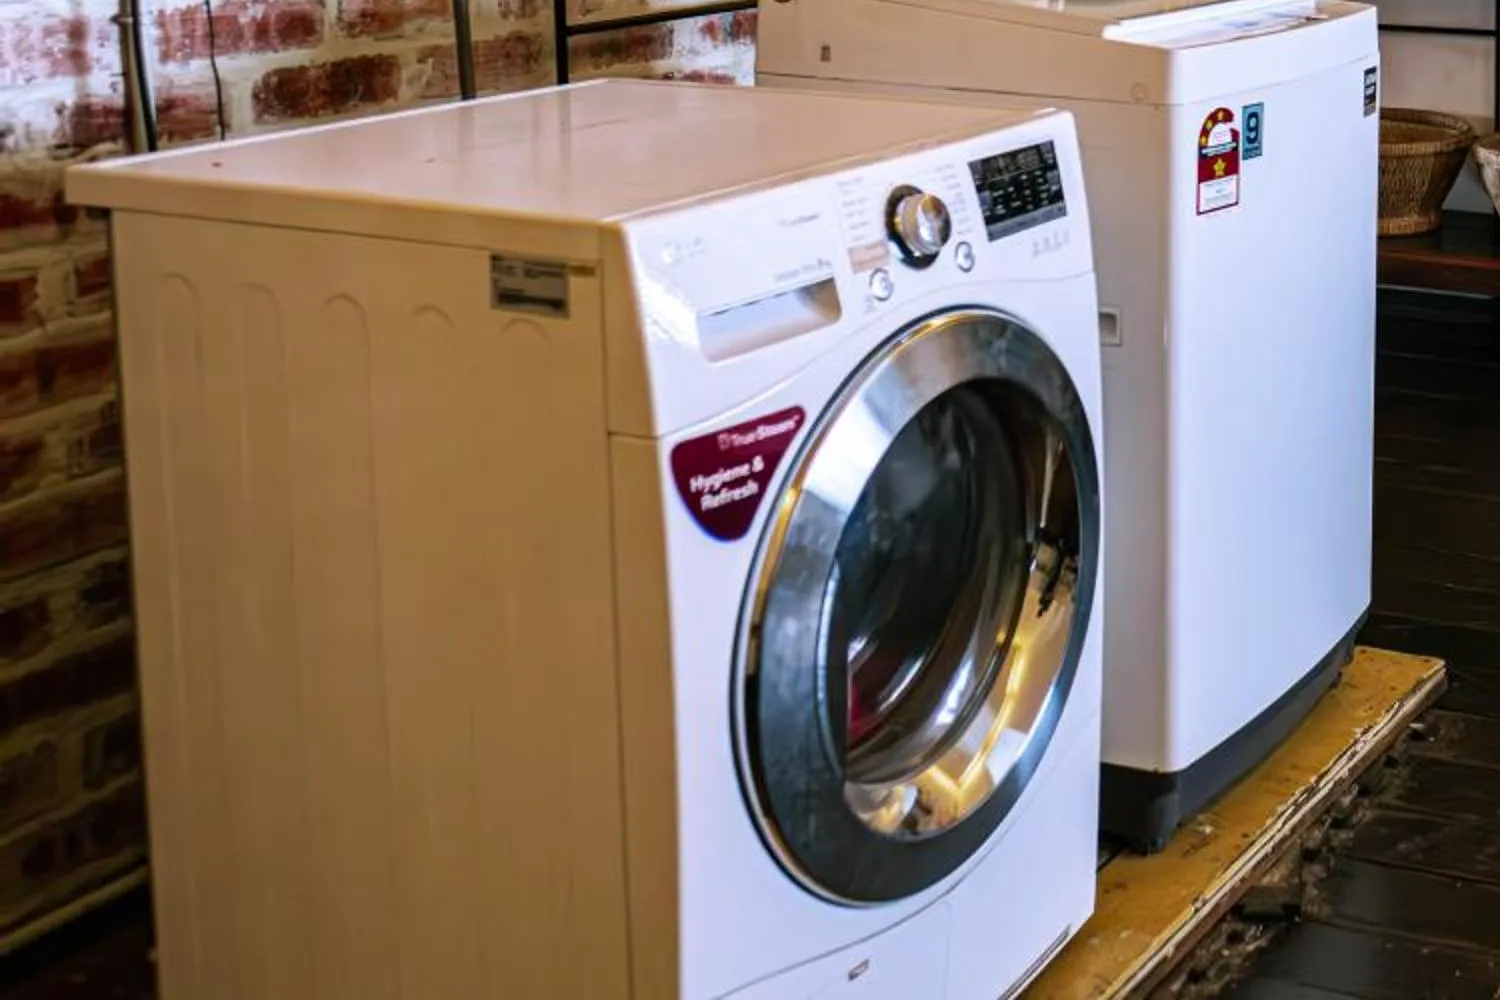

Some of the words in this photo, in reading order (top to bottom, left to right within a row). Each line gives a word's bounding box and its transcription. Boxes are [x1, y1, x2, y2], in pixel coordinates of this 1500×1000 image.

[1246, 111, 1260, 145] 9
[689, 463, 751, 493] Hygiene
[751, 455, 765, 473] &
[700, 478, 760, 512] Refresh
